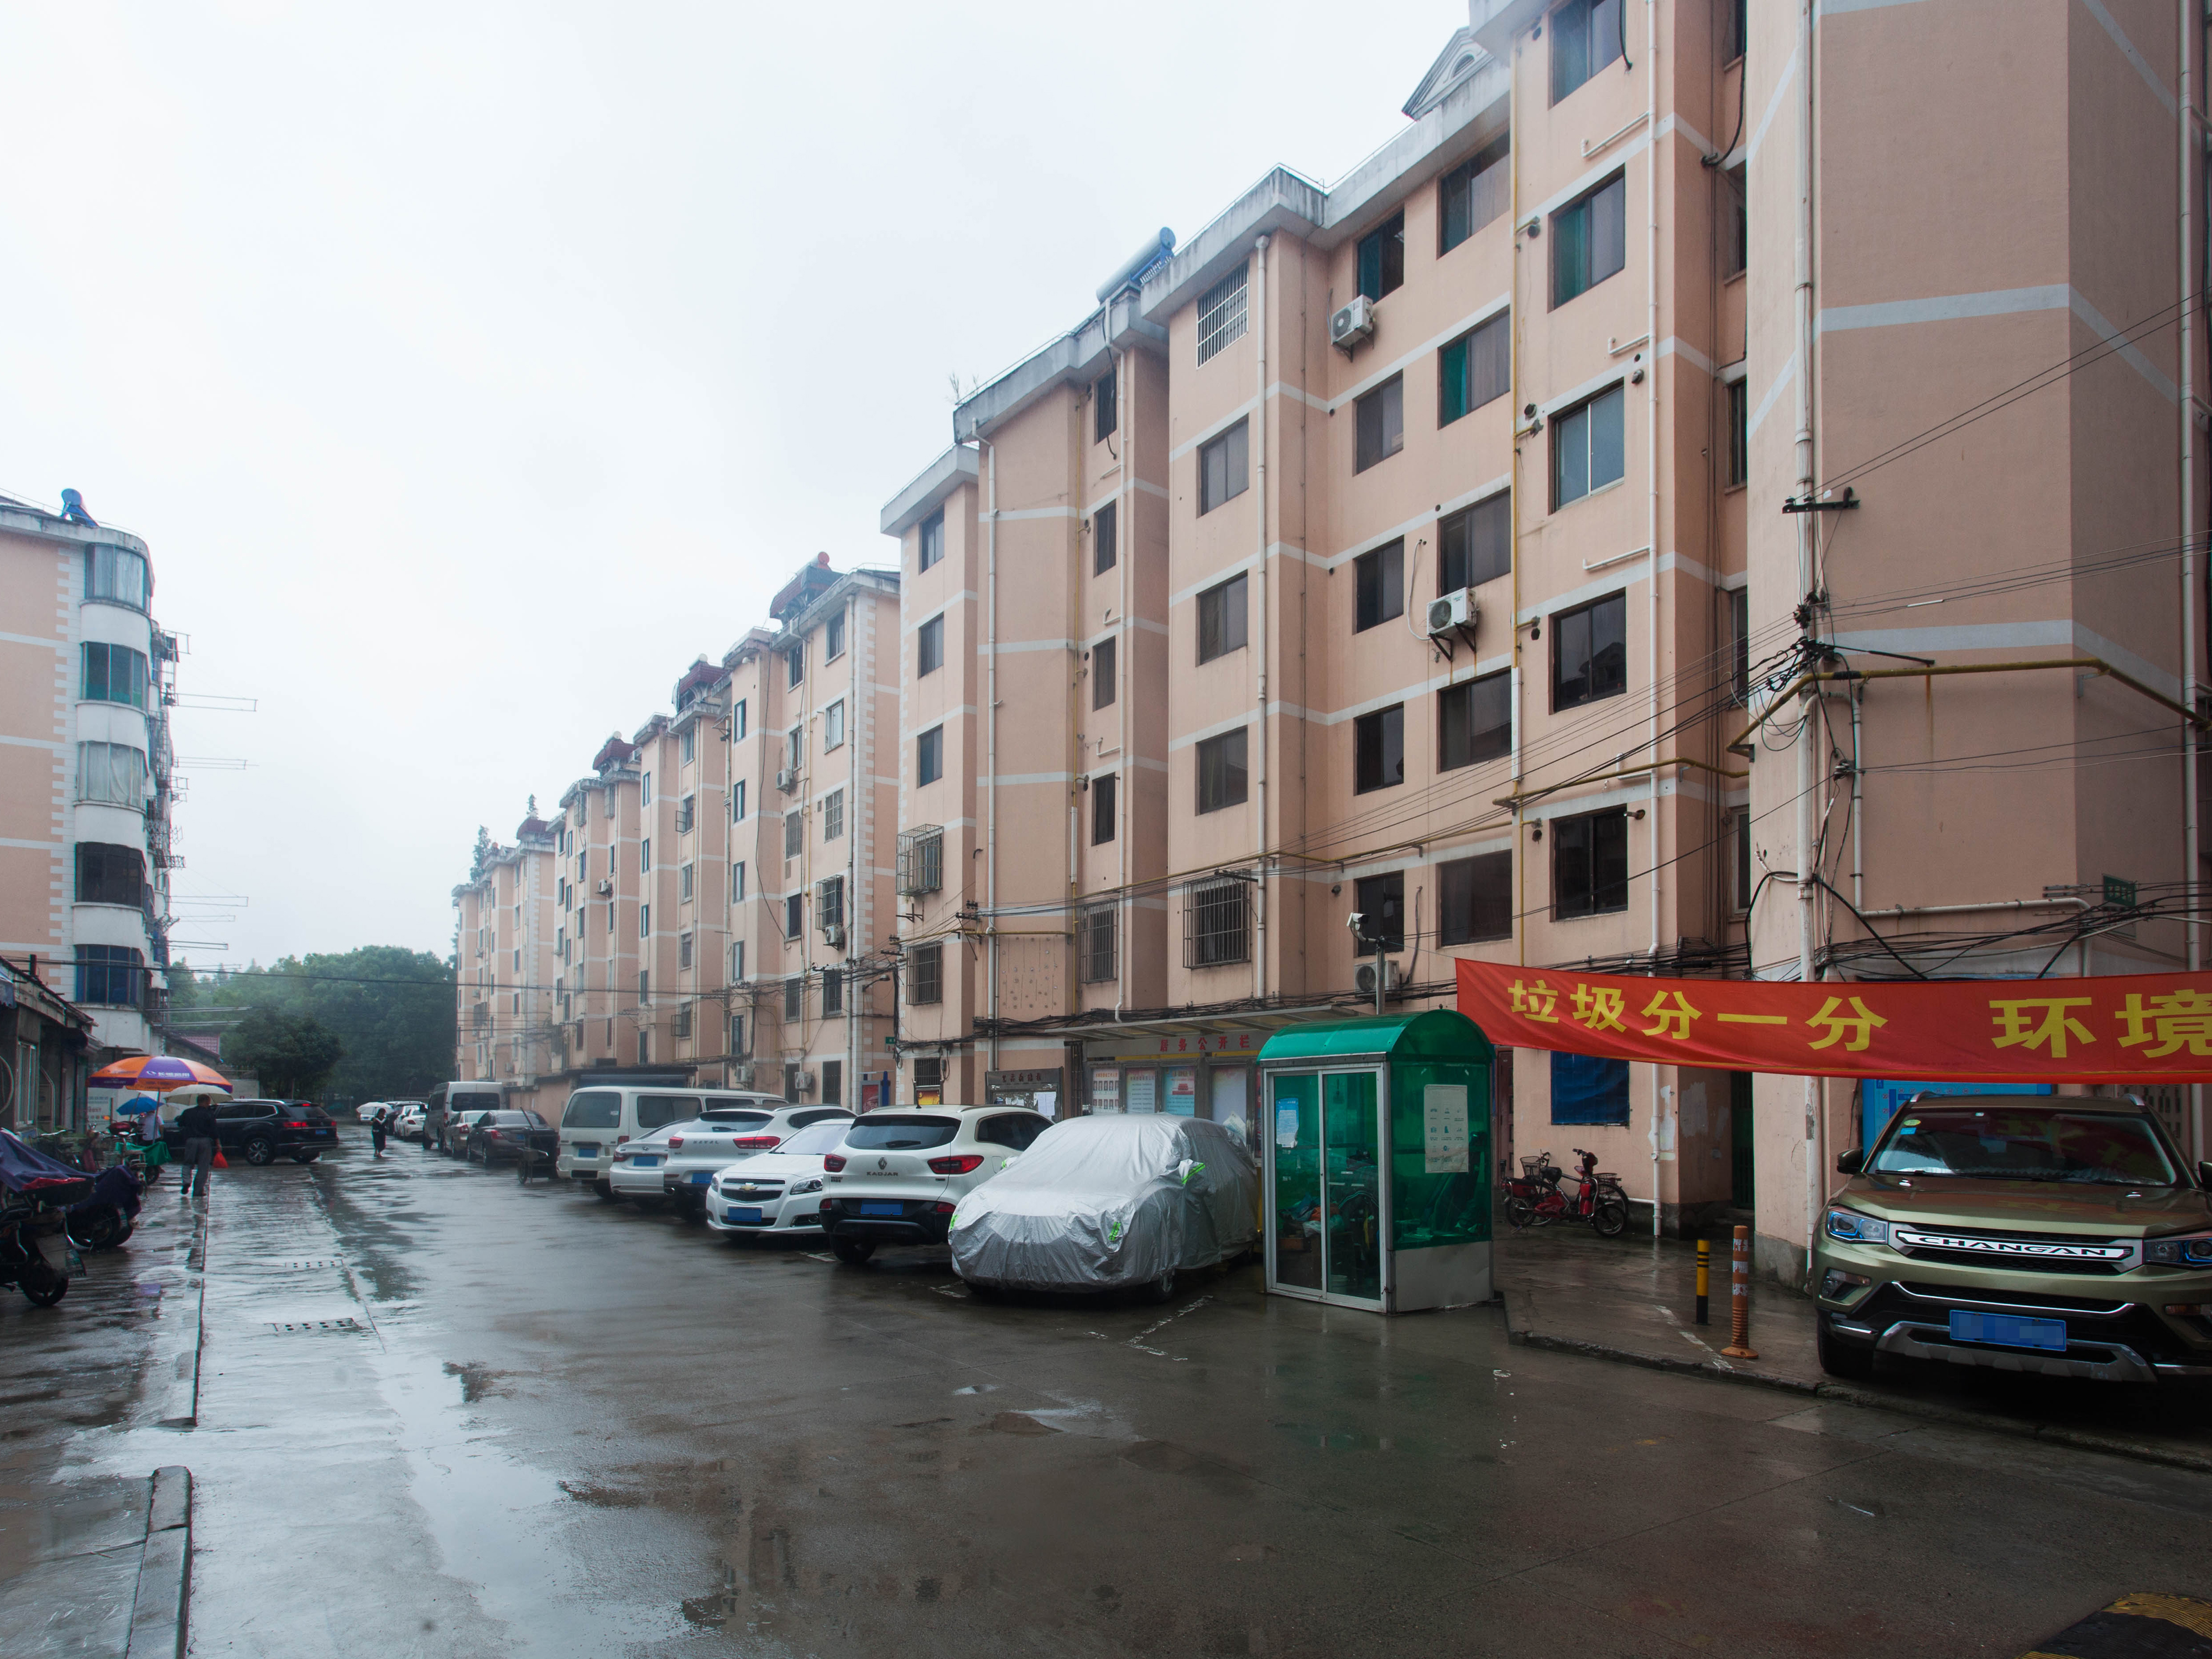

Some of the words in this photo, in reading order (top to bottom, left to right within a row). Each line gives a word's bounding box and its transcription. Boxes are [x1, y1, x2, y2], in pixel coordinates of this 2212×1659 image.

[1507, 979, 1888, 1051] 垃圾分一分
[1989, 989, 2212, 1058] 环境
[1159, 1034, 1250, 1052] 居务公开栏
[1918, 1237, 2106, 1256] CHANGAN
